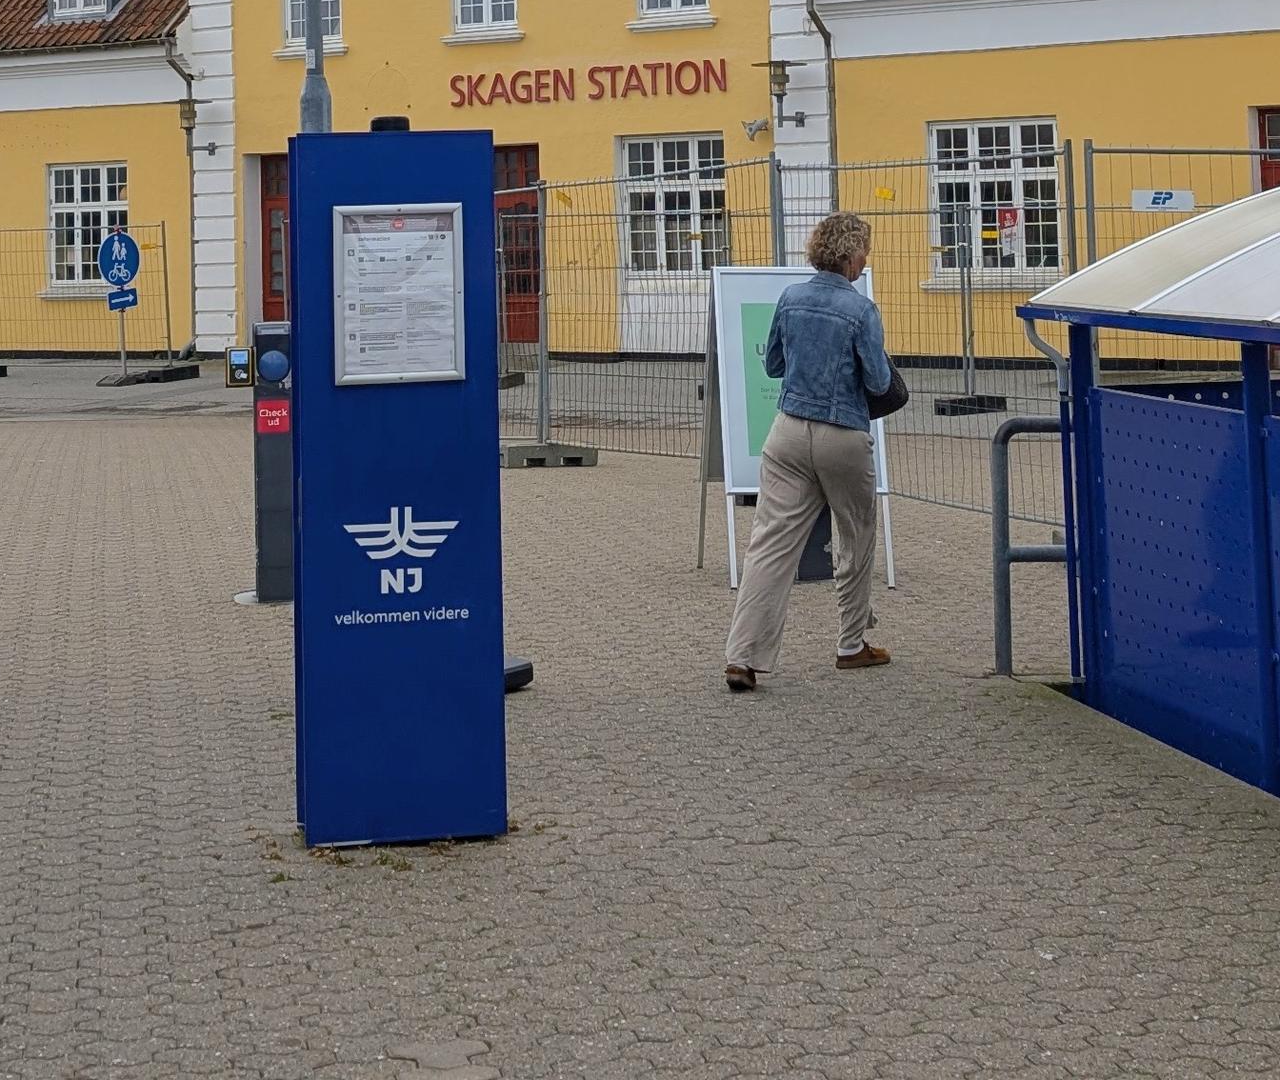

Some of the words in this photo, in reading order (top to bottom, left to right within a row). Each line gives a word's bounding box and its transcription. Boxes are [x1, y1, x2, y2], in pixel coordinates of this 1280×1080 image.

[449, 67, 575, 108] SKAGEN
[587, 58, 727, 100] STATION
[1151, 191, 1173, 205] EP
[259, 408, 288, 417] Check
[267, 418, 280, 426] ud
[380, 567, 423, 594] NJ
[334, 610, 420, 625] velkommen
[423, 606, 470, 620] videre
